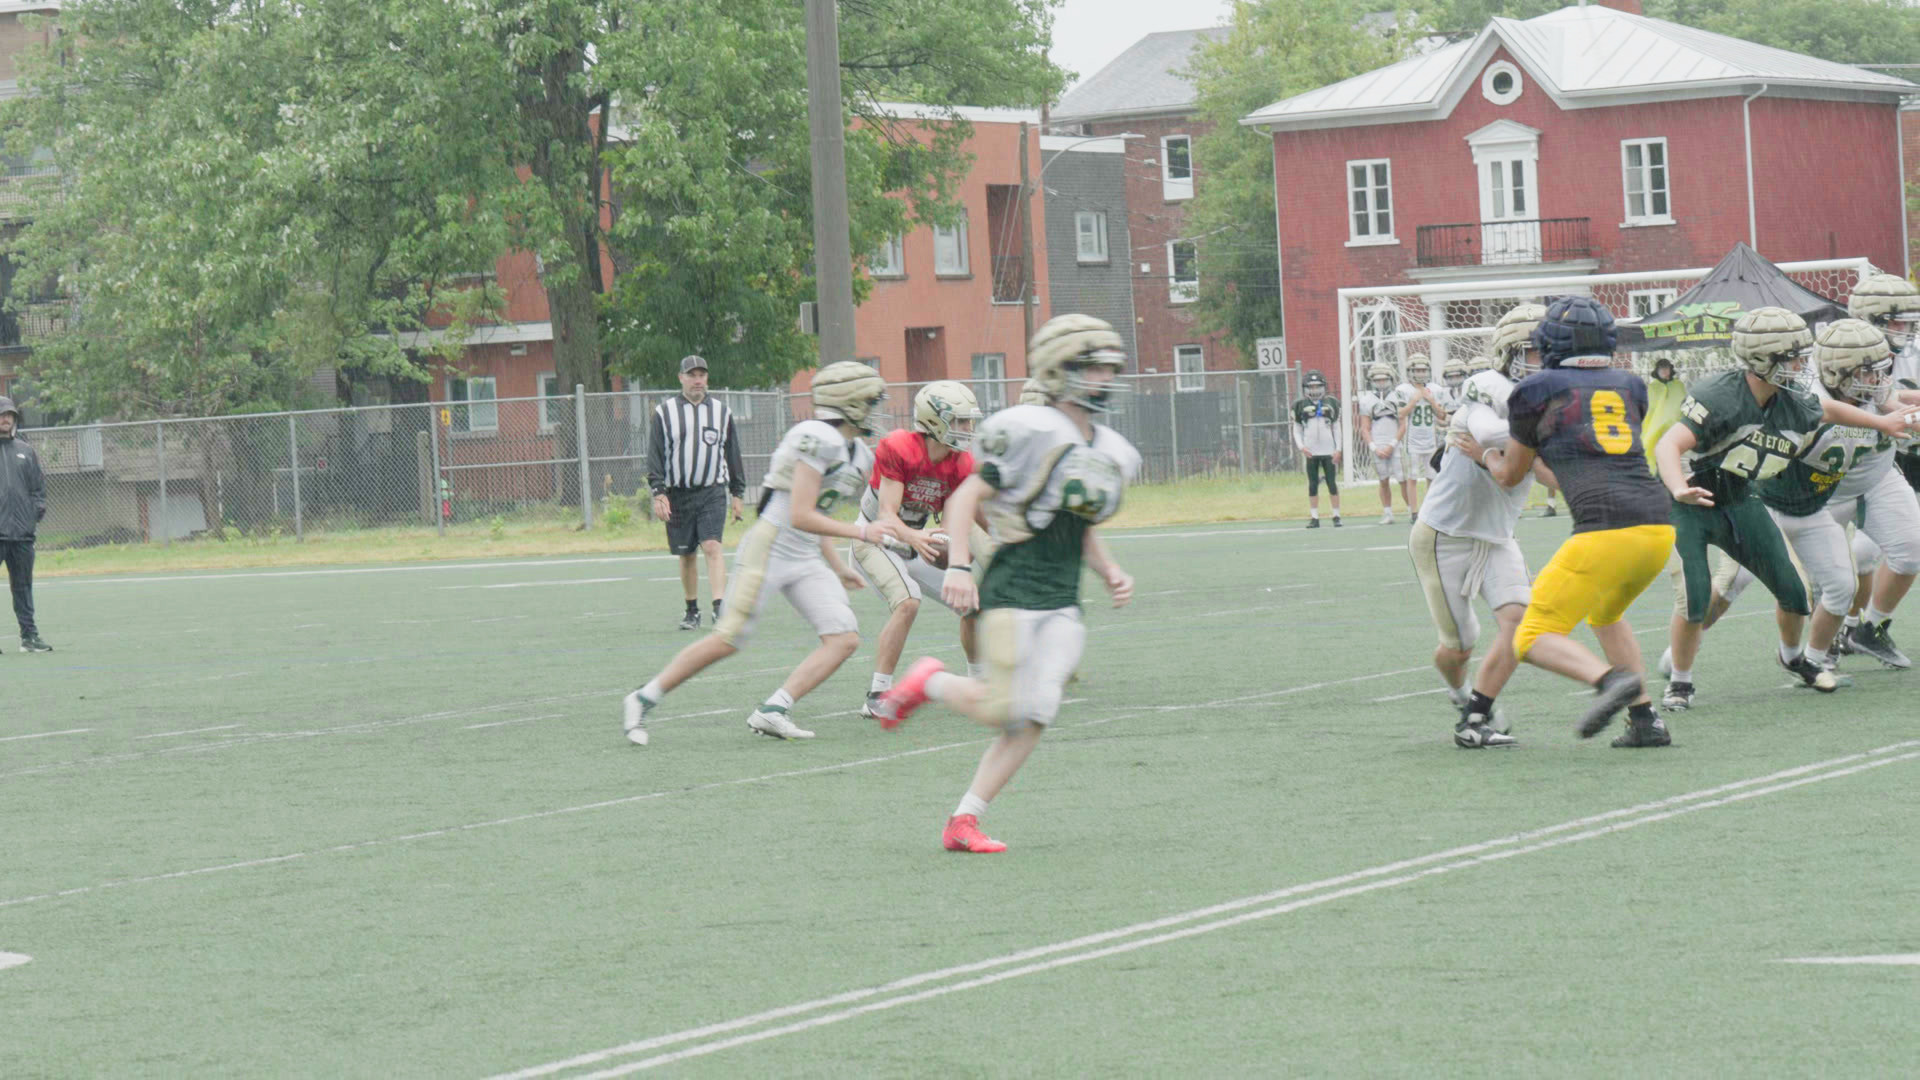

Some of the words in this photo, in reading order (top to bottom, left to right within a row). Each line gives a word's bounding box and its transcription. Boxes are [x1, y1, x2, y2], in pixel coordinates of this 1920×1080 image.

[1261, 346, 1282, 366] 30
[1412, 405, 1433, 426] 88
[1590, 390, 1633, 455] 8
